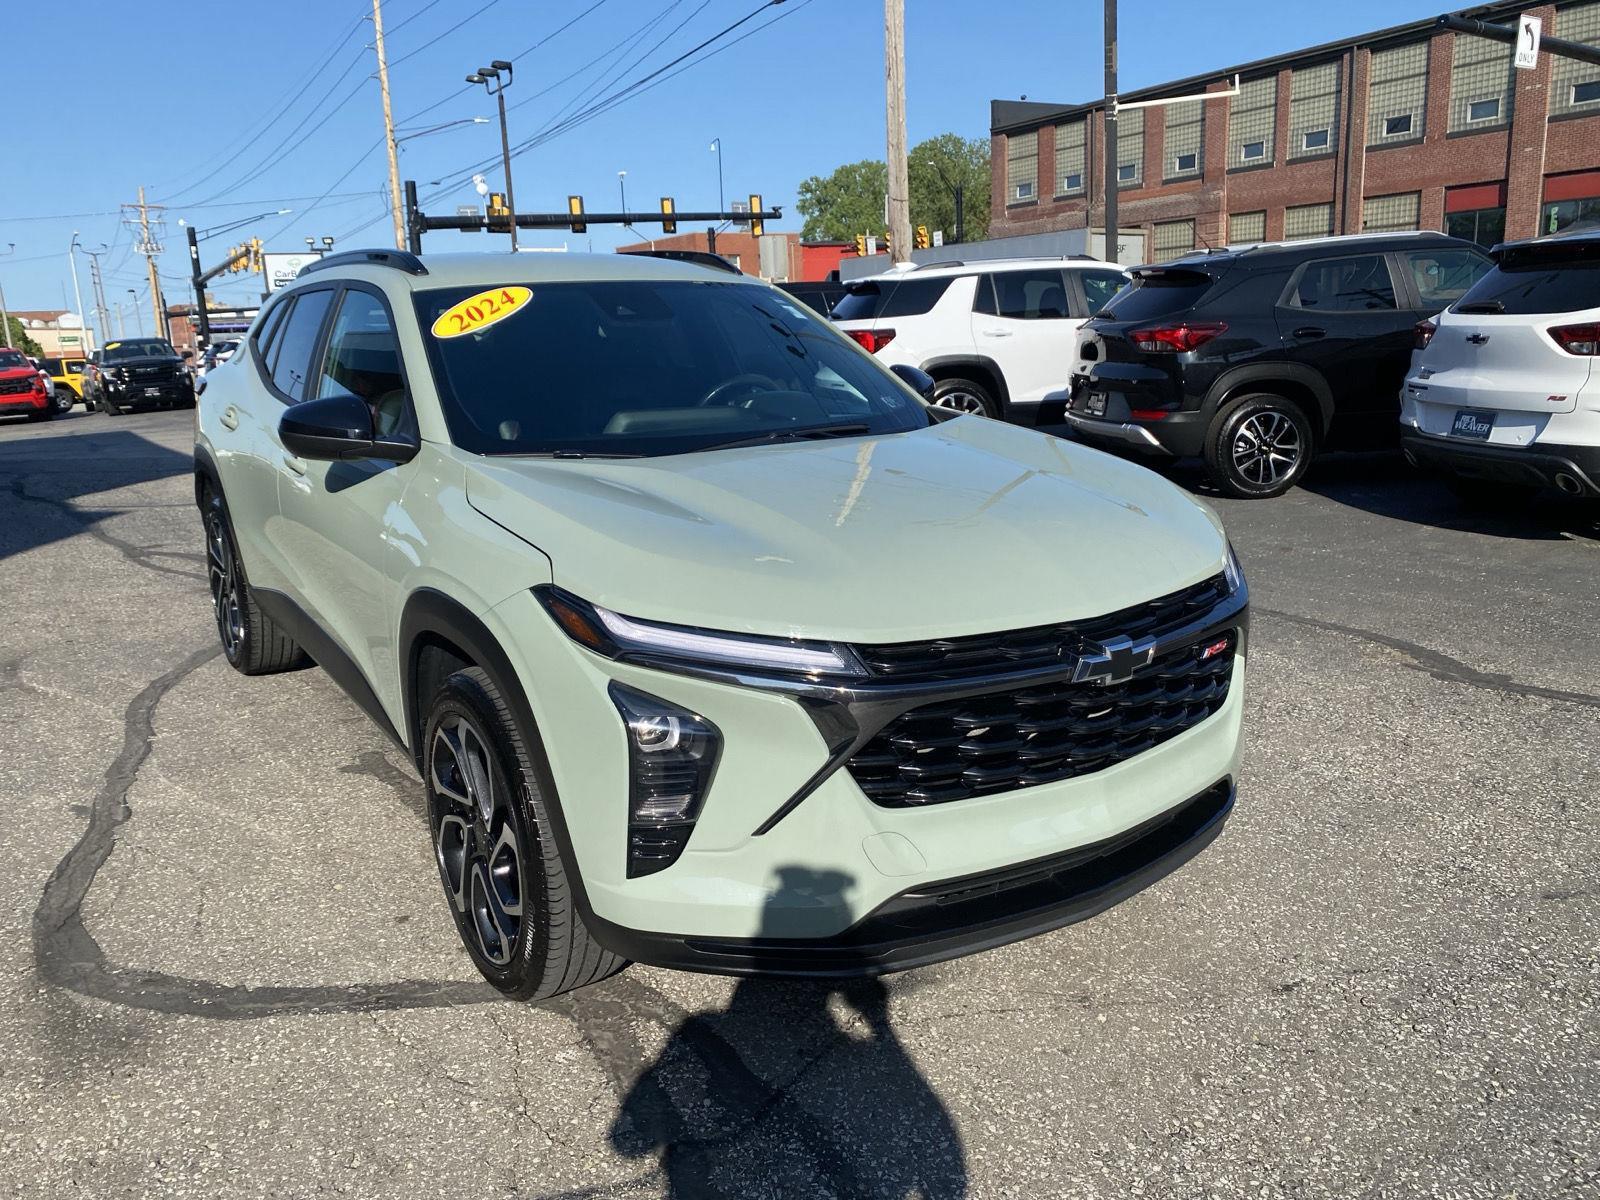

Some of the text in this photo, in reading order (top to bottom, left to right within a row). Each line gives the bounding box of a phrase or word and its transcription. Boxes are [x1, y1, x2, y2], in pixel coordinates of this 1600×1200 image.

[1518, 52, 1536, 64] ONLY
[449, 289, 515, 332] 2024
[1454, 420, 1491, 432] WEAVER
[1202, 638, 1228, 659] RS
